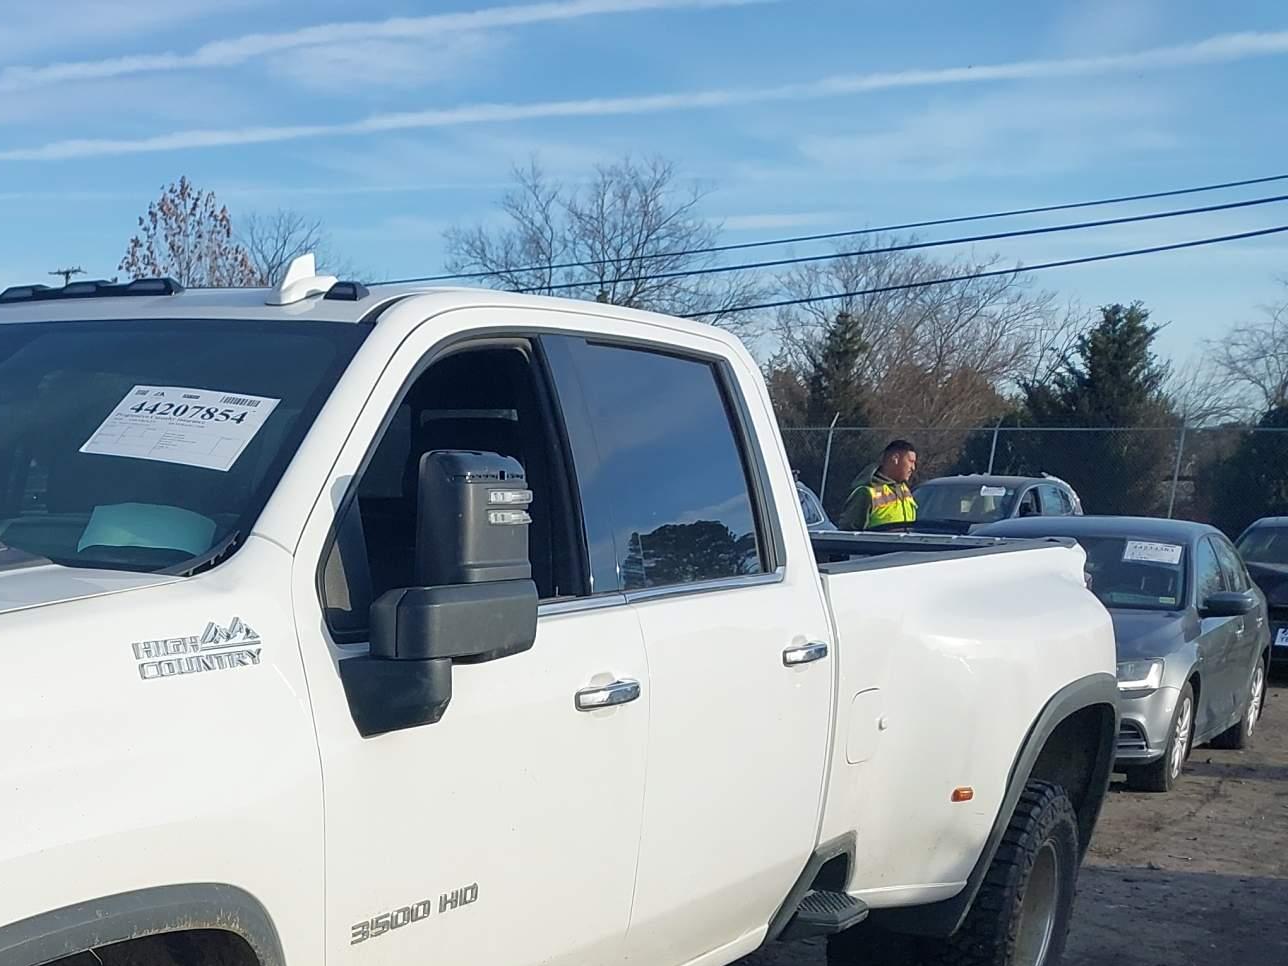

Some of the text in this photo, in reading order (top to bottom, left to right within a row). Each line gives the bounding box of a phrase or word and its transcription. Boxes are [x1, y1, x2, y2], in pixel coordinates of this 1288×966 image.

[130, 400, 249, 425] 44207854
[132, 636, 201, 660] HIGH
[139, 648, 262, 680] COUNTRY
[350, 882, 479, 945] 3500 HD
